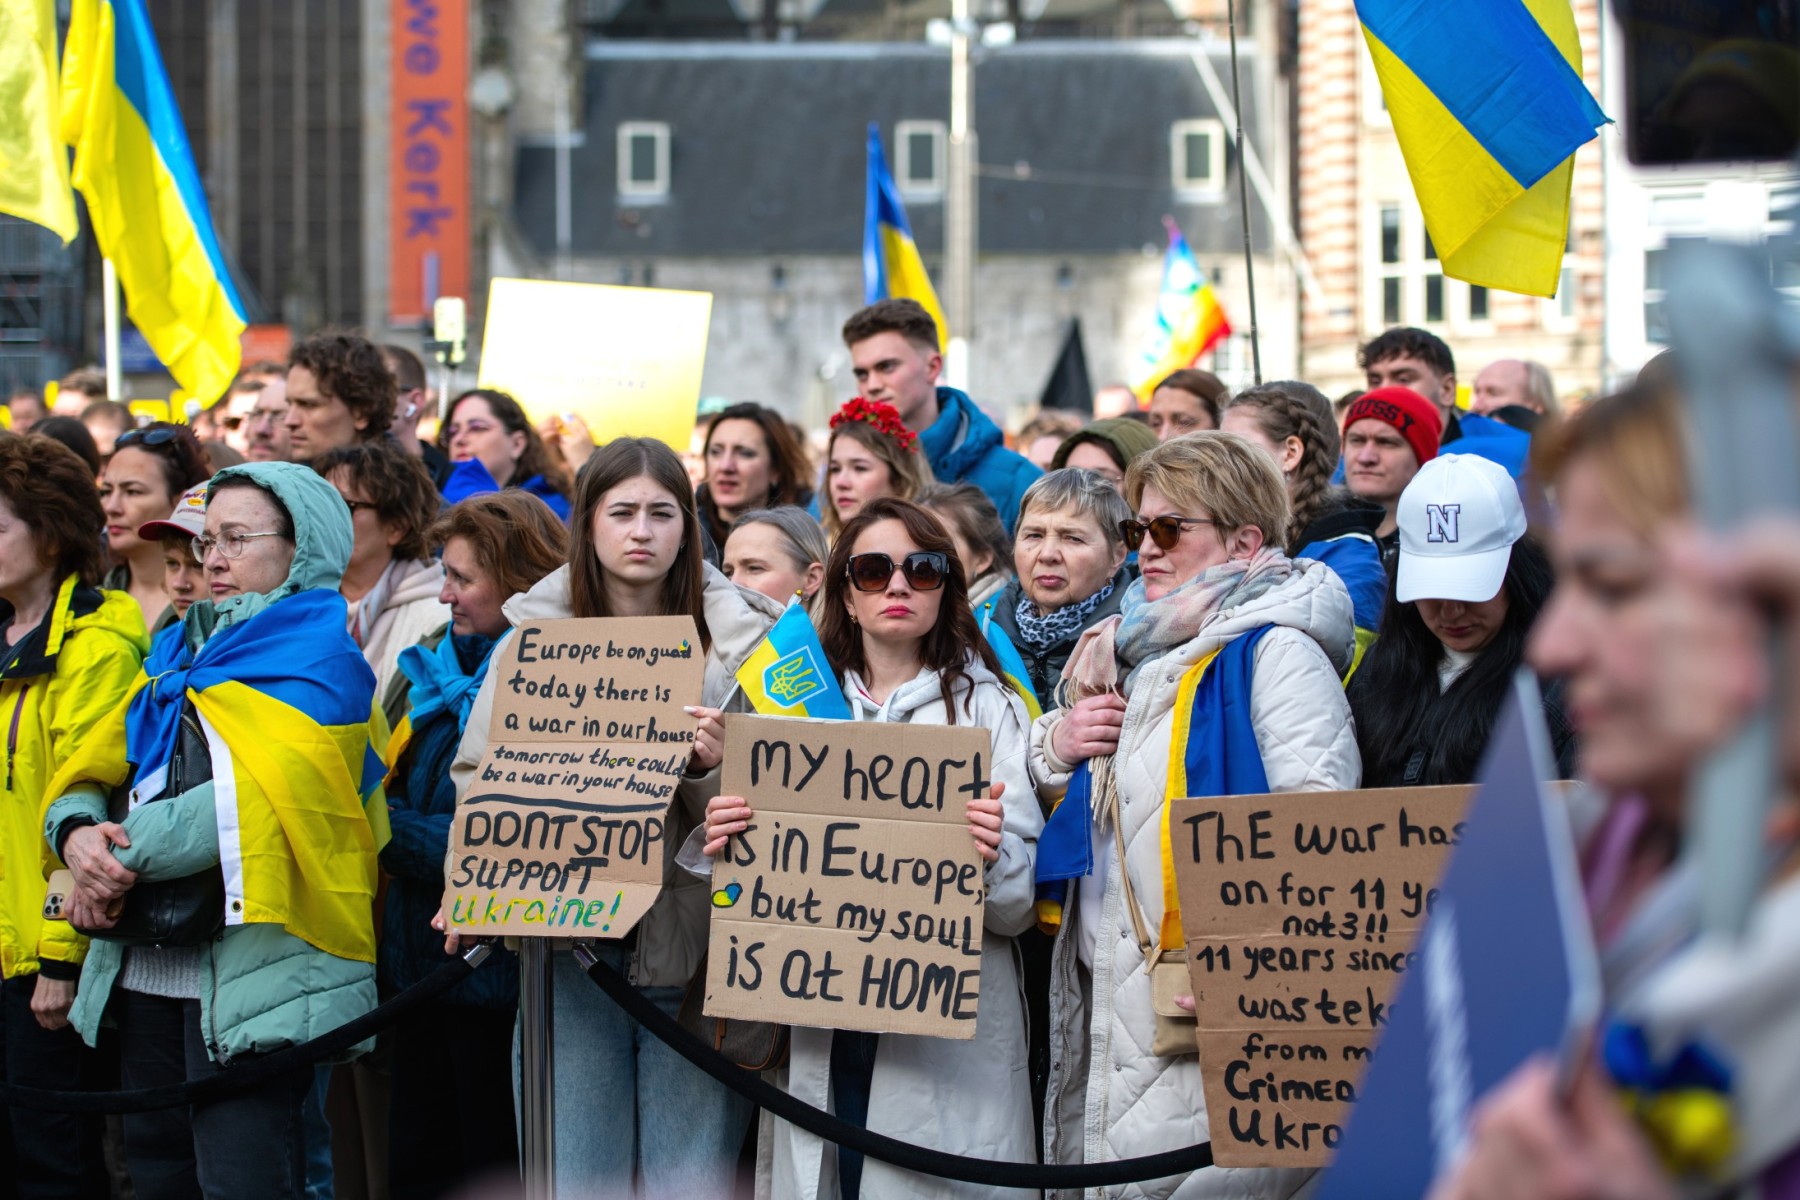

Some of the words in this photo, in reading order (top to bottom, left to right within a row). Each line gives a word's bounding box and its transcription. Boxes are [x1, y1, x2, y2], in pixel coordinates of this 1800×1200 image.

[1427, 504, 1461, 543] N
[517, 628, 601, 664] Europe
[606, 640, 624, 658] be
[627, 646, 646, 660] on
[508, 669, 587, 708] today
[594, 677, 649, 702] there
[655, 684, 671, 702] is
[505, 713, 519, 730] a
[529, 716, 576, 733] war
[583, 716, 600, 737] in
[606, 720, 646, 740] our
[646, 716, 695, 742] house
[481, 763, 503, 782] be
[505, 771, 517, 783] a
[521, 773, 560, 787] war
[561, 771, 580, 786] in
[582, 775, 625, 794] your
[625, 774, 674, 799] house
[494, 745, 585, 764] tomorrow
[589, 748, 636, 770] there
[636, 753, 687, 779] could
[844, 749, 990, 812] heart
[574, 815, 664, 866] STOP
[1294, 822, 1387, 855] war
[1399, 807, 1468, 848] has
[771, 822, 808, 873] in
[821, 823, 983, 905] Europe,
[751, 876, 823, 923] but
[836, 903, 887, 943] my
[1220, 880, 1269, 906] on
[1277, 872, 1336, 906] for
[1350, 877, 1386, 911] 11
[1282, 911, 1336, 938] not
[726, 935, 766, 990] is
[780, 949, 844, 1001] at
[858, 954, 981, 1020] HOME
[1197, 944, 1230, 973] 11
[1243, 946, 1336, 980] years
[1238, 994, 1310, 1022] was
[1242, 1033, 1328, 1061] from
[1342, 1045, 1381, 1062] m
